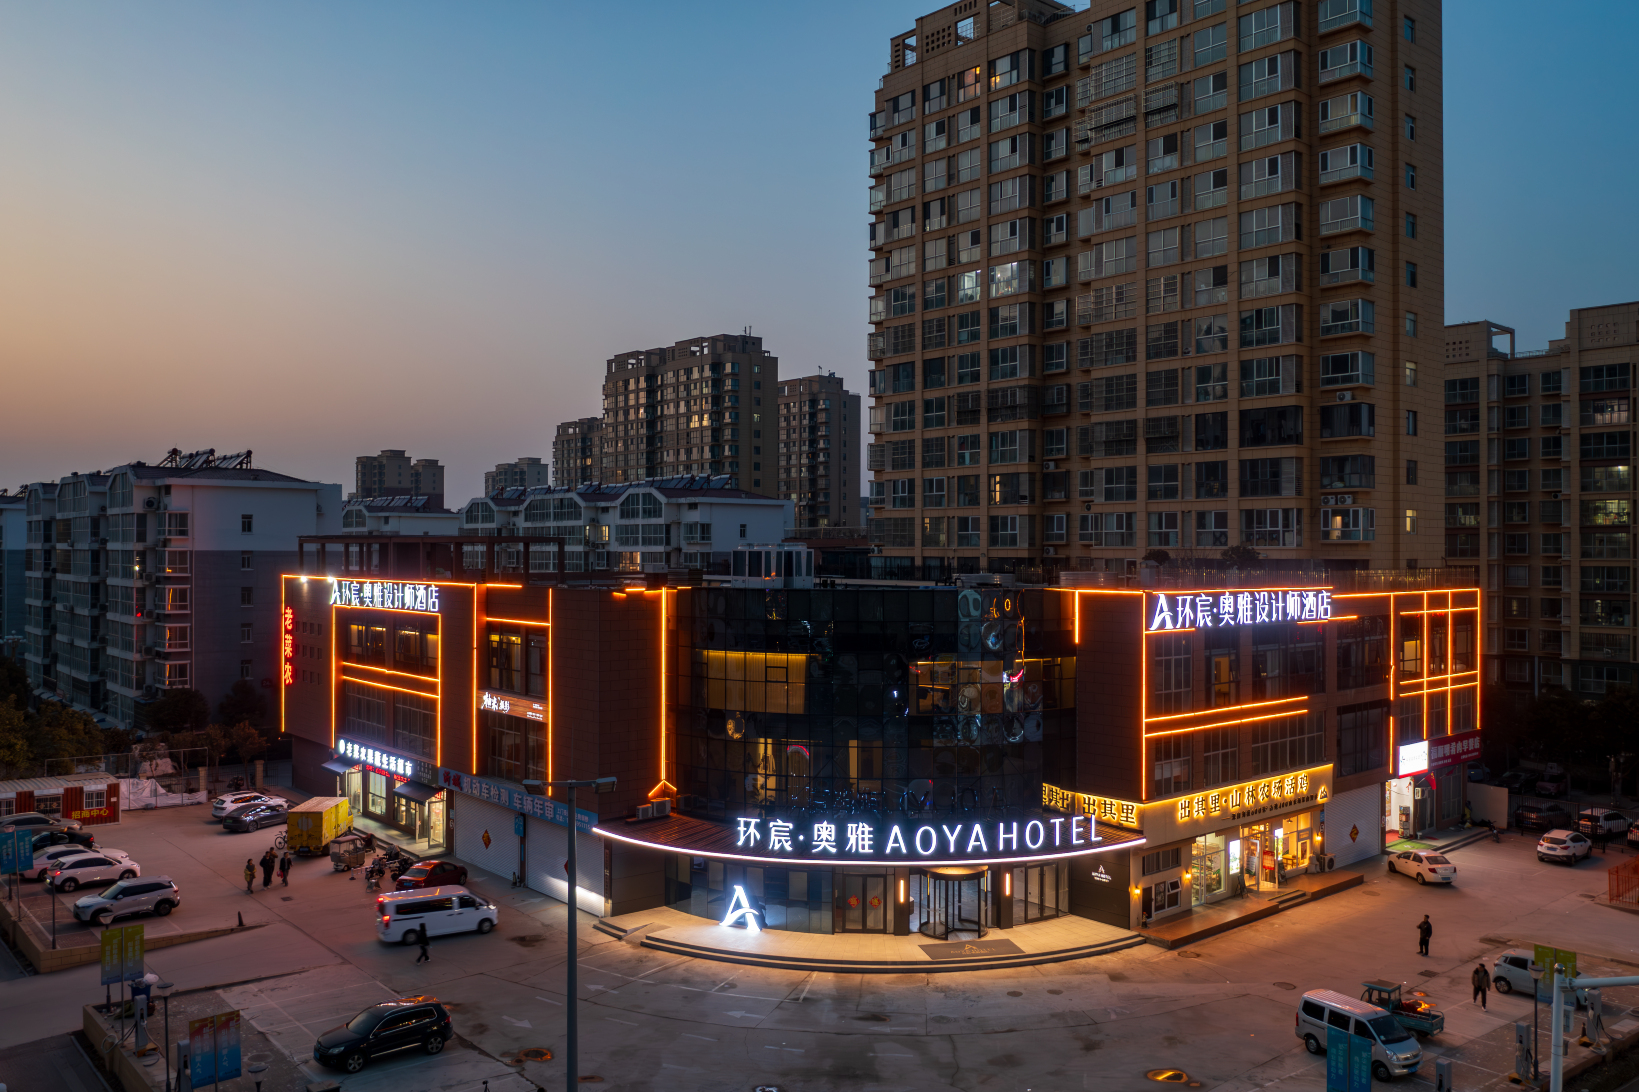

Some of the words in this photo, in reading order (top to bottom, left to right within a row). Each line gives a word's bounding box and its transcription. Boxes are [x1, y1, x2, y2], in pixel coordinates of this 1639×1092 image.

[284, 606, 293, 685] 老菜农
[71, 808, 109, 820] 招商中心
[1083, 797, 1136, 824] 出其里
[736, 816, 874, 852] 环宸·奥雅
[885, 823, 988, 855] AOYA
[999, 814, 1103, 851] HOTEL
